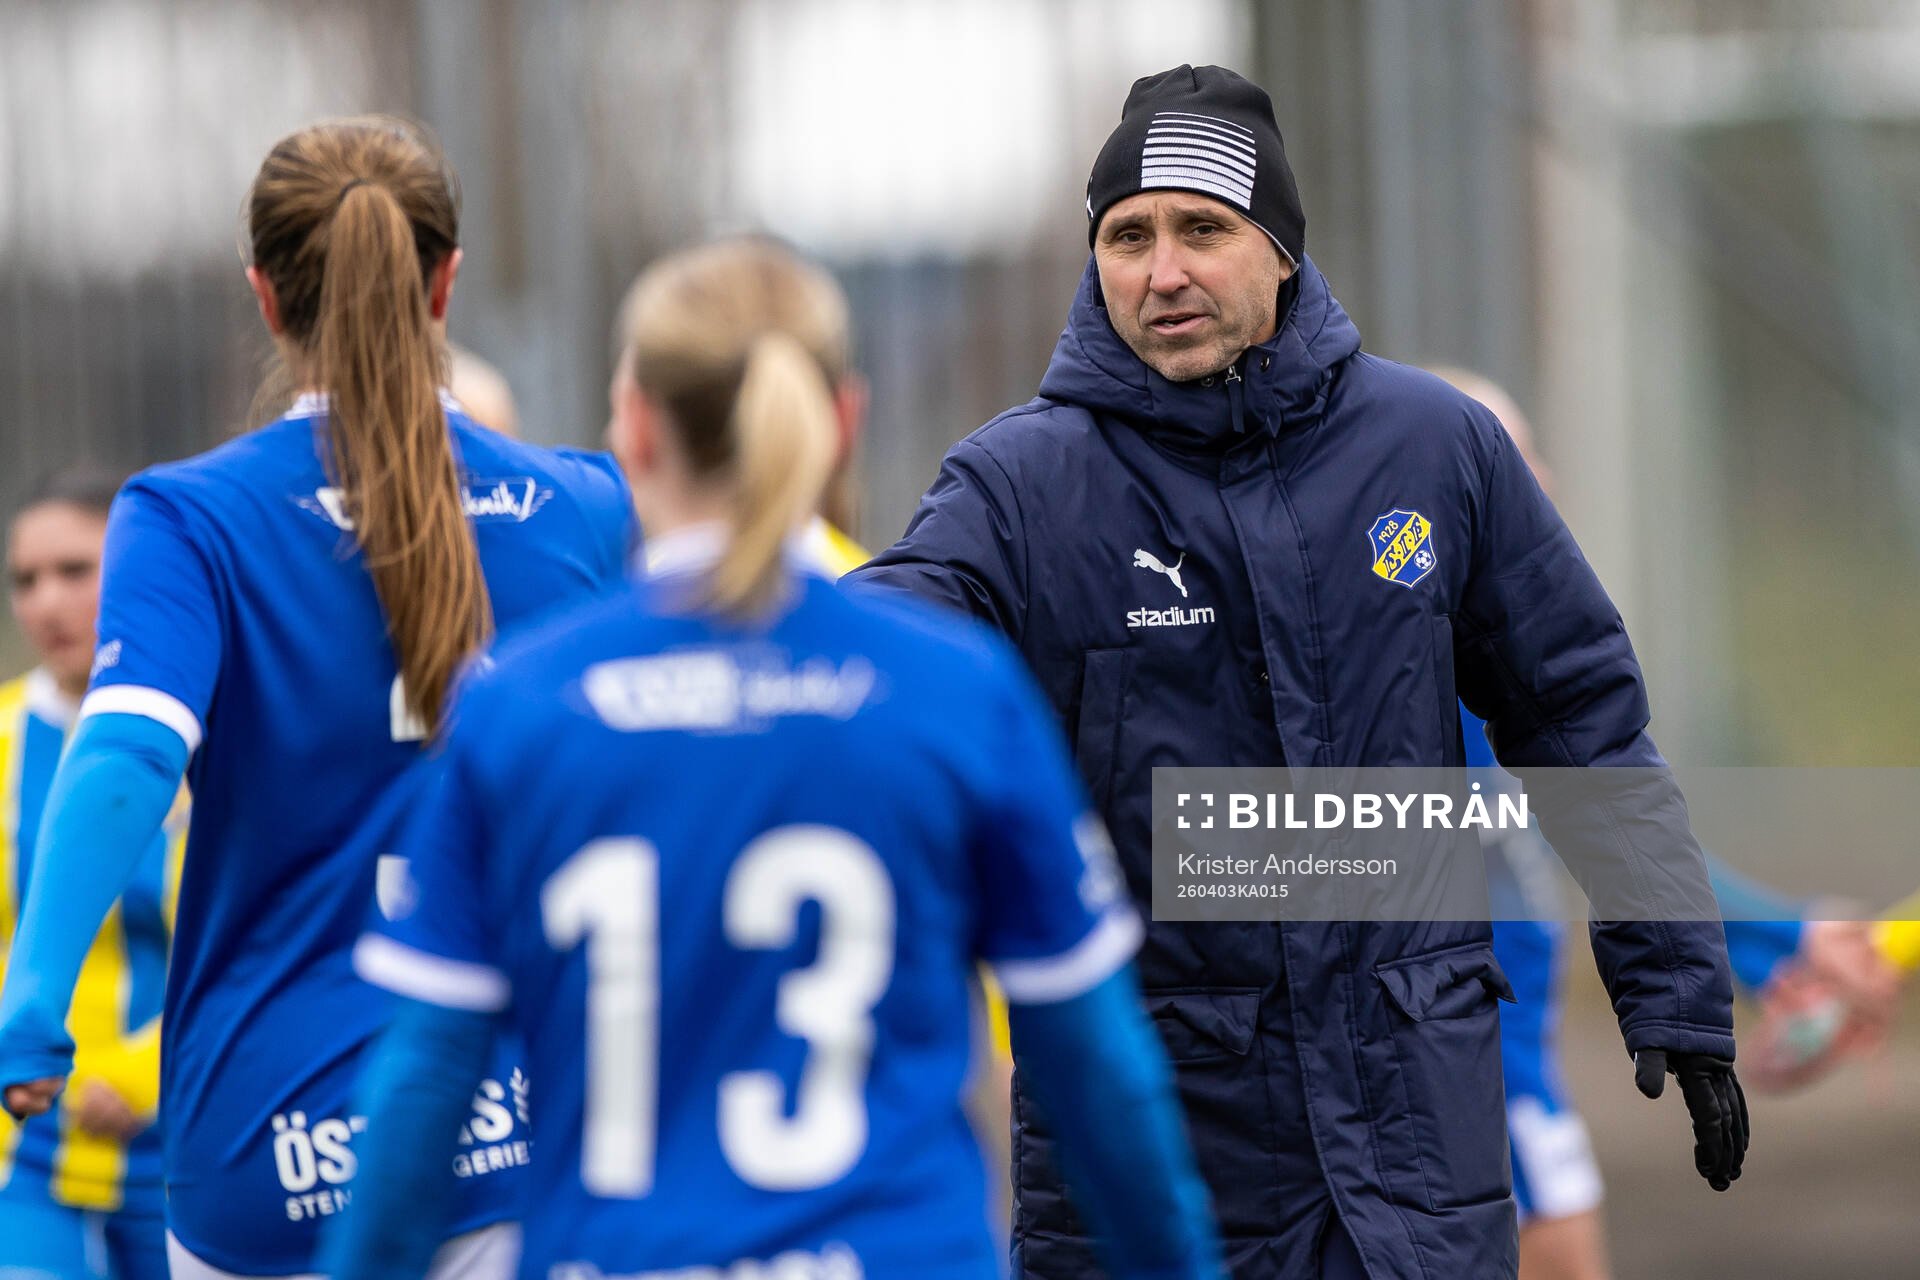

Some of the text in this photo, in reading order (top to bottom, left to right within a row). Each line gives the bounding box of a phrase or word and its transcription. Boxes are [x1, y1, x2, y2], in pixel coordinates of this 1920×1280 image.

[1378, 520, 1399, 544] 1928
[1126, 606, 1215, 628] stadium
[541, 824, 897, 1199] 13
[271, 1110, 369, 1193] ÖS
[452, 1140, 531, 1178] GERIE
